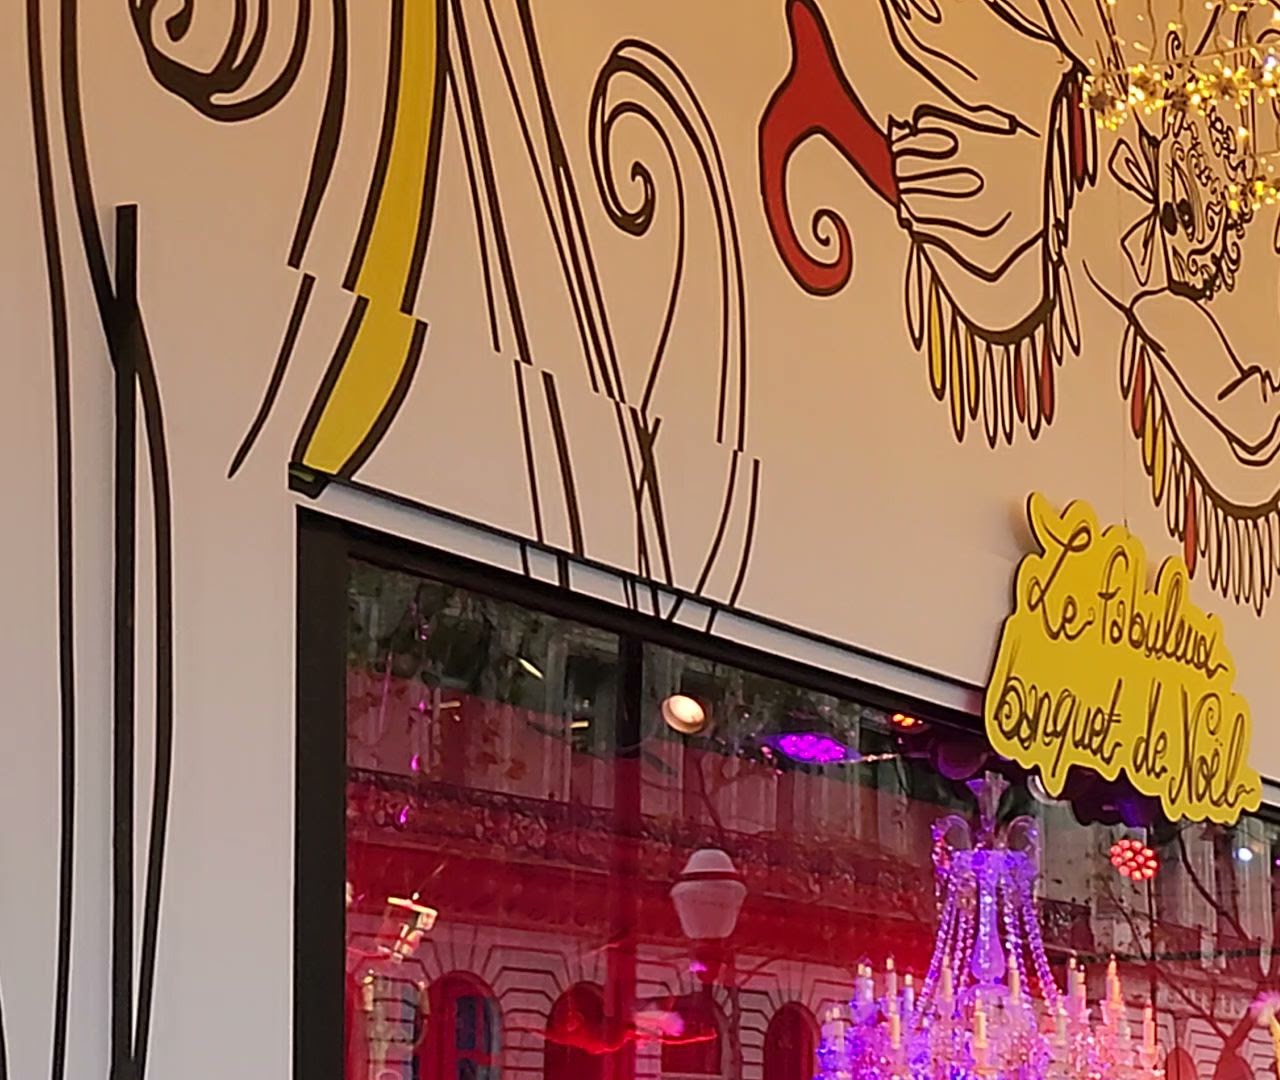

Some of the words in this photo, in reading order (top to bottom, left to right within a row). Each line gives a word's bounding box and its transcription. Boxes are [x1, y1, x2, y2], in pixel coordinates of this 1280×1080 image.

[1027, 513, 1096, 641] Le
[1132, 678, 1167, 780] de
[1168, 684, 1256, 808] Noël
